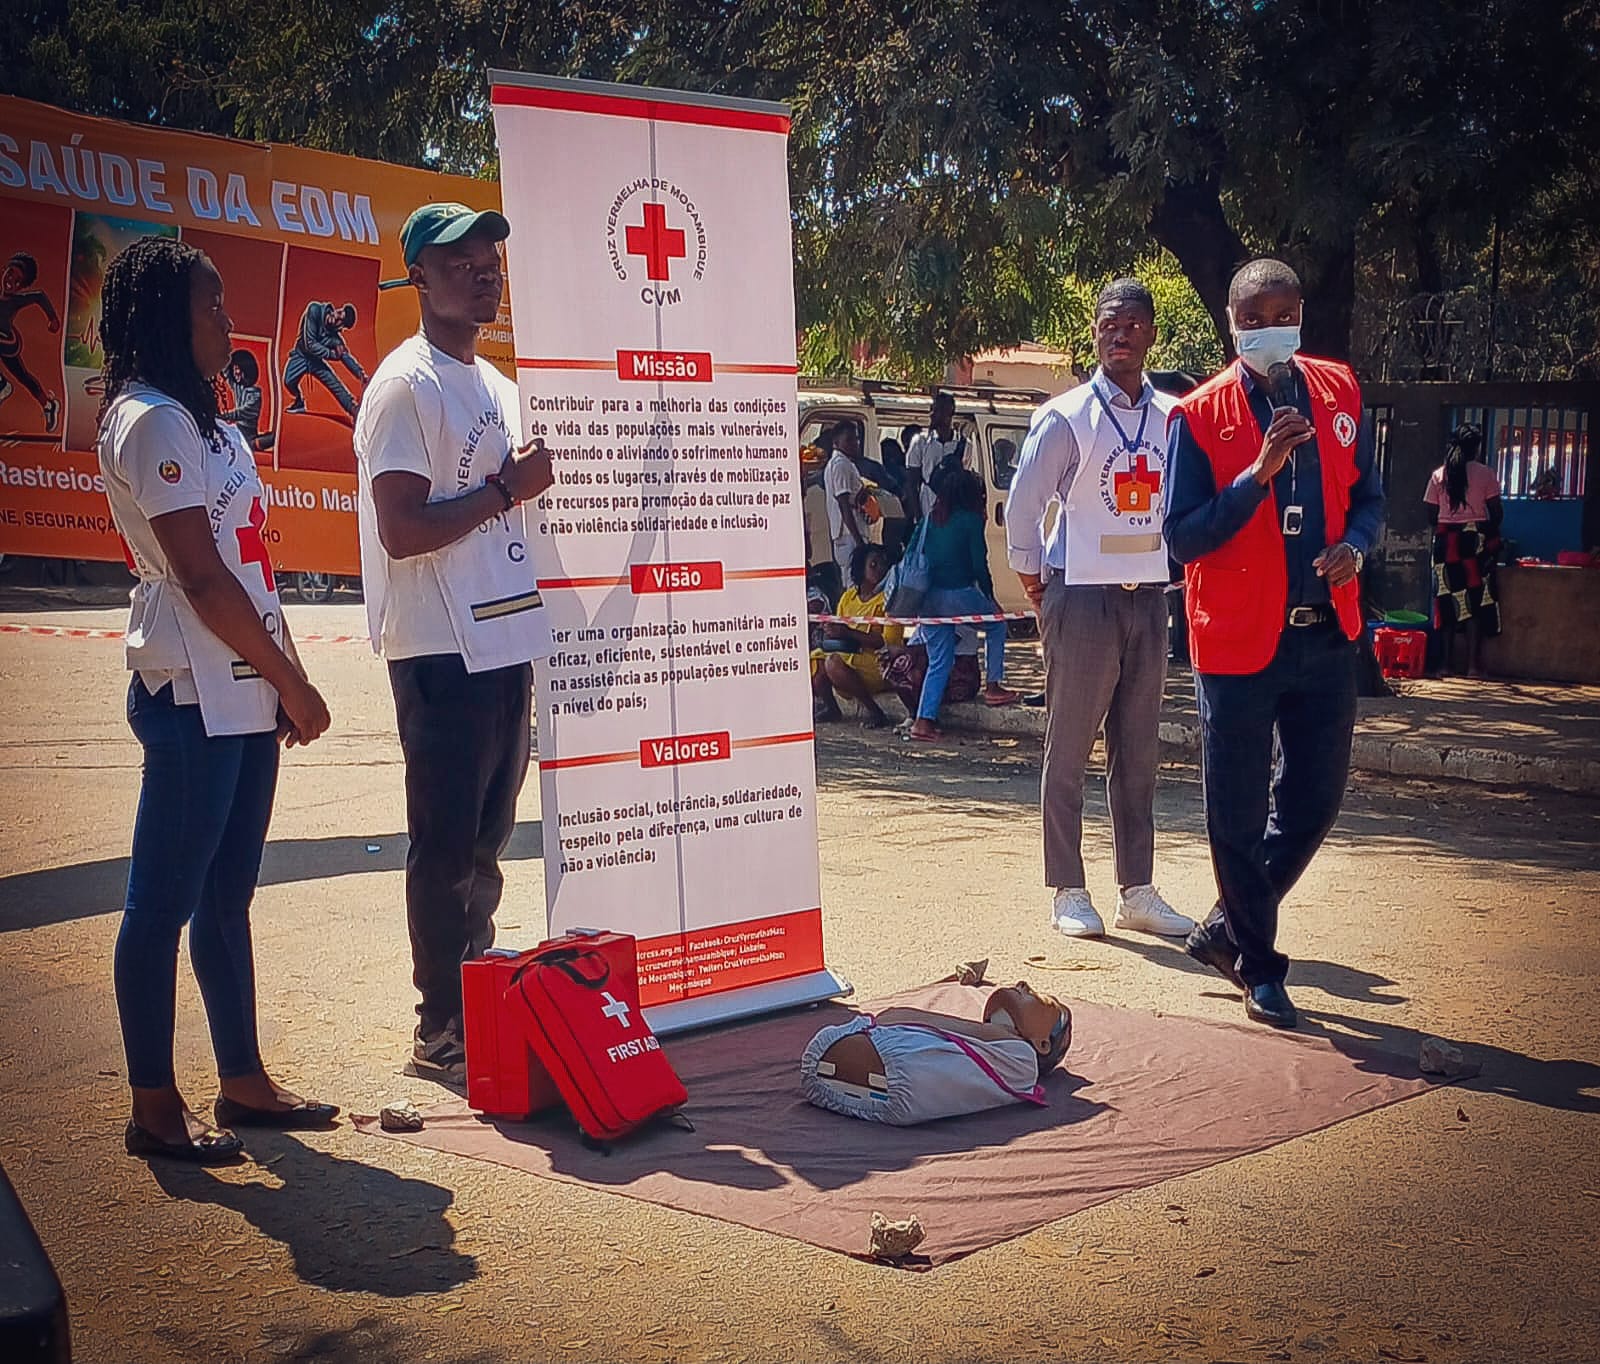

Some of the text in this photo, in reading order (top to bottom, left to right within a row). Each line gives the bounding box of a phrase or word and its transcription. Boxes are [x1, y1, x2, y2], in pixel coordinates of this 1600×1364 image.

[0, 134, 380, 246] SAÚDE DA EDM
[651, 178, 668, 191] DE
[607, 178, 650, 237] VERMELHA
[607, 239, 627, 281] CRUZ
[641, 287, 681, 307] CVM
[633, 354, 697, 377] Missão
[530, 396, 786, 416] Contribuir para a melhoria das condições
[532, 420, 548, 436] de
[556, 421, 581, 436] vida
[588, 421, 609, 436] das
[616, 422, 680, 440] populações
[687, 422, 715, 436] mais
[722, 421, 788, 438] vulneráveis,
[617, 446, 669, 460] aliviando
[672, 449, 679, 460] o
[682, 445, 743, 460] sofrimento
[745, 445, 788, 459] humano
[560, 470, 592, 485] todos
[596, 472, 610, 484] os
[613, 469, 662, 487] lugares,
[664, 468, 706, 484] através
[710, 468, 724, 484] de
[726, 467, 790, 486] mobilização
[1100, 446, 1127, 487] VERMEL
[322, 489, 358, 513] Mai
[538, 492, 790, 514] de recursos para promoção da cultura de paz
[1101, 490, 1122, 518] CRUZ
[24, 511, 117, 535] SEGURANÇA
[540, 522, 548, 534] e
[551, 518, 572, 534] não
[576, 516, 628, 534] violência
[630, 514, 708, 532] solidariedade
[711, 518, 718, 530] e
[653, 566, 701, 588] Visão
[578, 628, 605, 642] uma
[611, 620, 687, 641] organização
[692, 616, 764, 634] humanitária
[769, 613, 798, 630] mais
[549, 635, 798, 668] eficaz, eficiente, sustentável e confiável
[551, 658, 799, 692] na assistência as populações vulneráveis
[552, 692, 647, 716] a nível do país;
[651, 740, 720, 763] Valores
[558, 783, 802, 828] Inclusão social, tolerância, solidariedade,
[558, 806, 802, 852] respeito pela diferença, uma cultura de
[560, 854, 584, 874] não
[586, 858, 594, 870] a
[607, 1039, 645, 1063] FIRST
